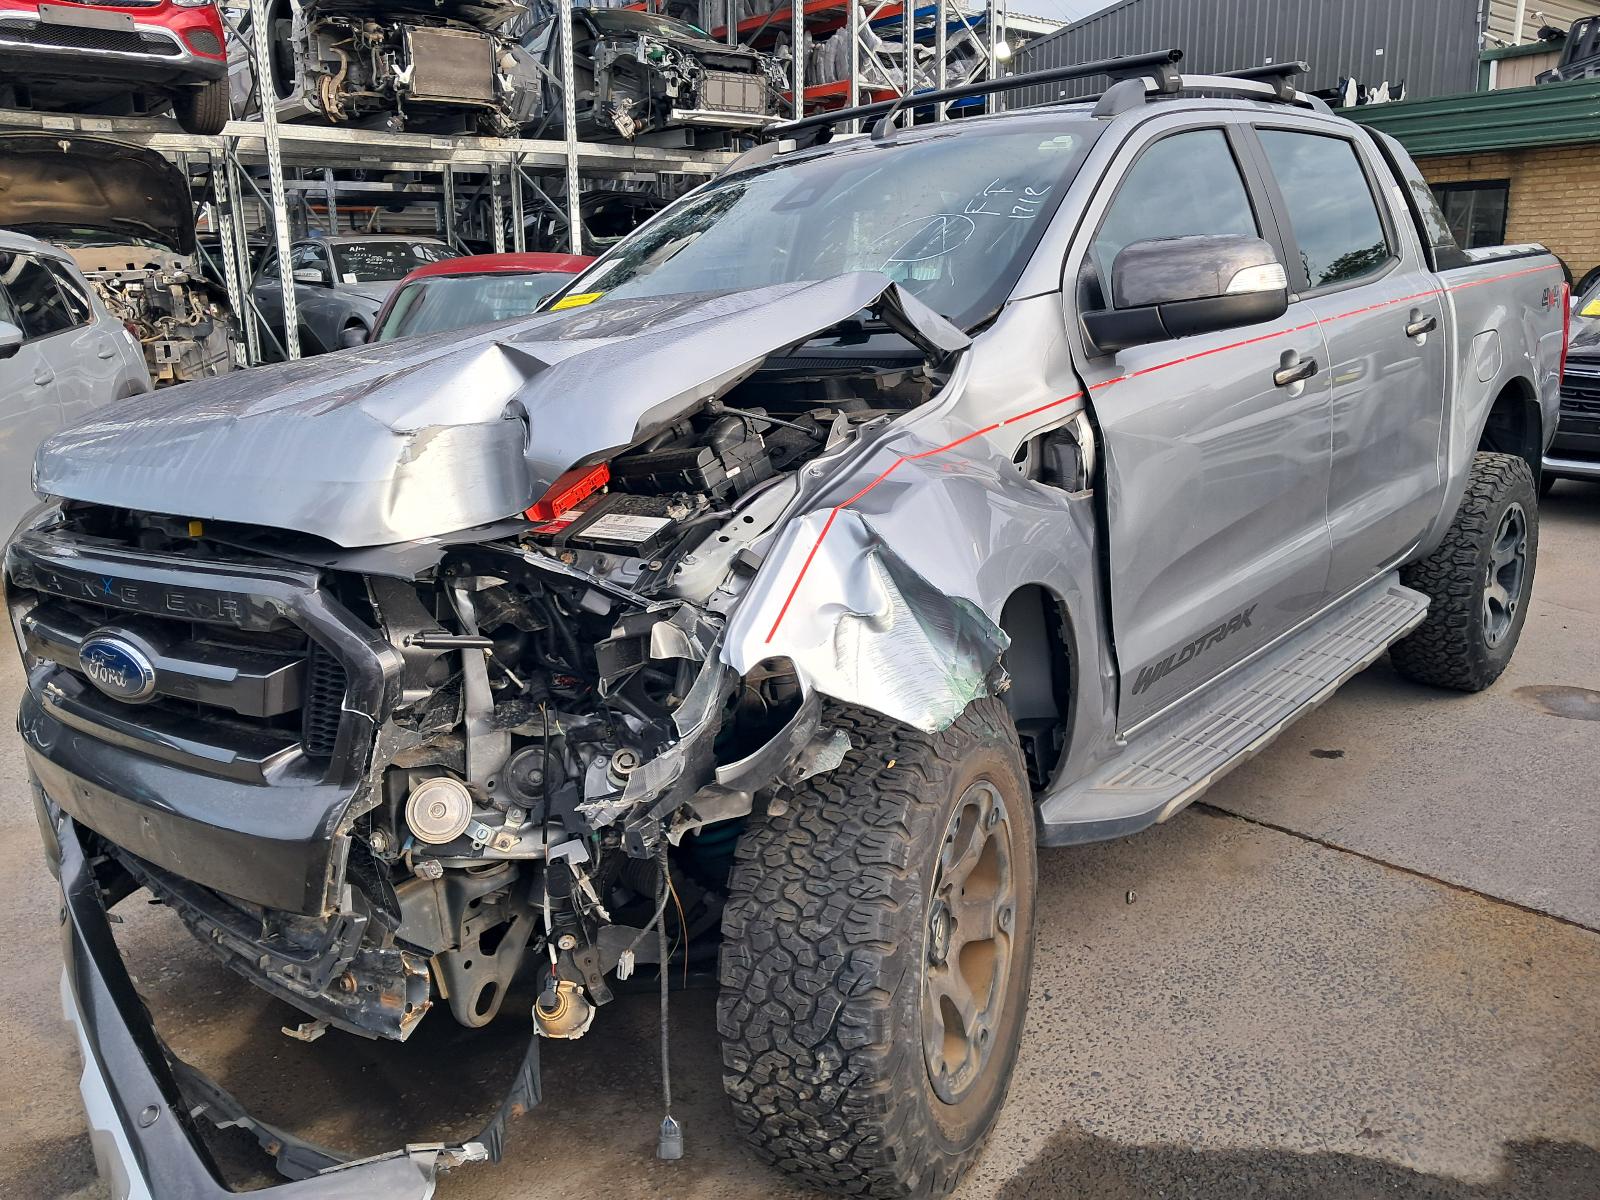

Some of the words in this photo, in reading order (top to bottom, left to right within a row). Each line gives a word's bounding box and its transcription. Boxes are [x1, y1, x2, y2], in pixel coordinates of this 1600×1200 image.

[17, 566, 241, 618] ANGER
[88, 650, 128, 689] Ford
[1131, 602, 1259, 695] WILDTRAK
